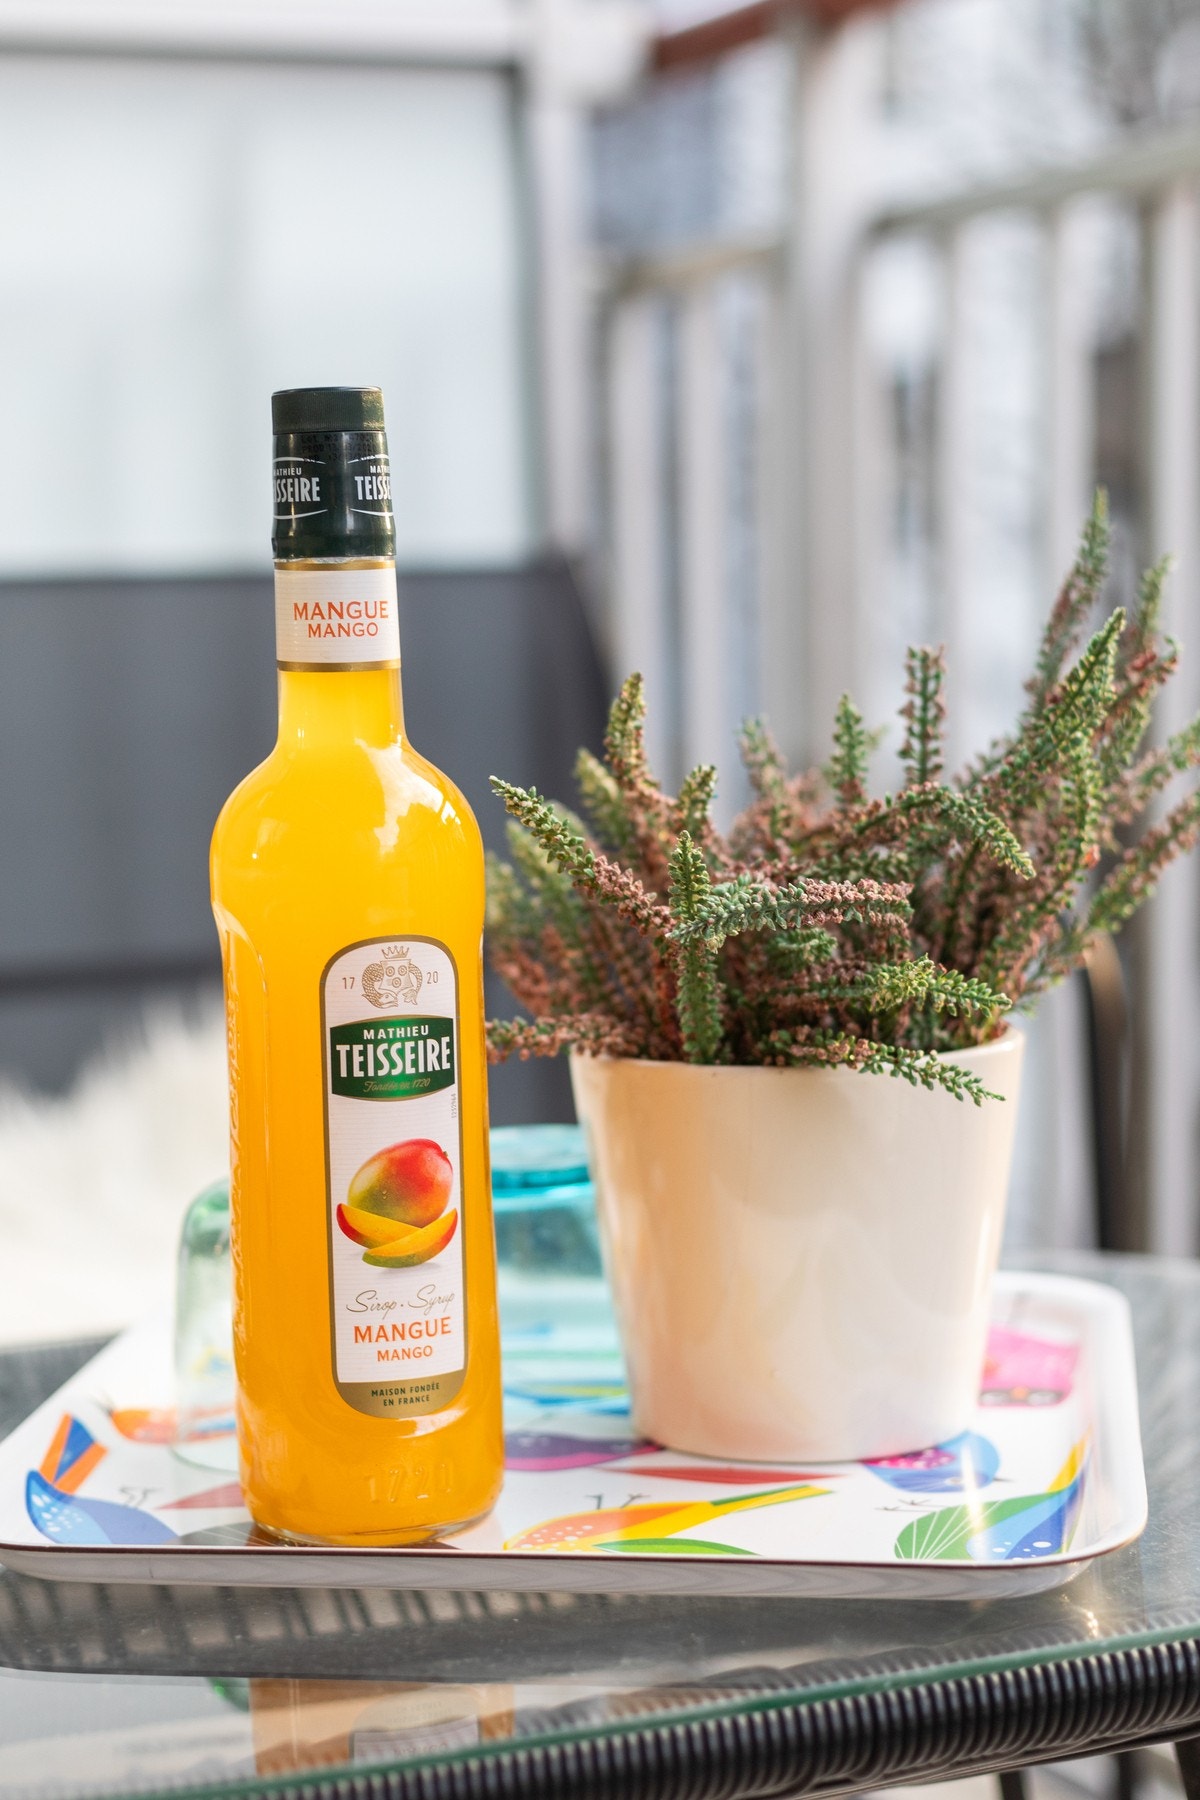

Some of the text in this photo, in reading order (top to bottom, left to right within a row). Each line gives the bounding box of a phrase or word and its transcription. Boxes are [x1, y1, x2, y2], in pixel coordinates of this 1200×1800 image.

[273, 477, 321, 503] ISSEIRE
[354, 475, 391, 500] TEISSE
[293, 600, 389, 621] MANGUE
[308, 621, 379, 638] MANGO
[342, 971, 439, 990] 17 20
[363, 1024, 430, 1040] MATHIEU
[335, 1036, 451, 1078] TEISSEIRE
[412, 1077, 432, 1089] 1720
[346, 1284, 455, 1320] Sirop Syrup
[353, 1316, 452, 1344] MANGUE
[376, 1345, 433, 1362] MANGO
[371, 1382, 441, 1398] MAISON FONDÉE
[383, 1394, 431, 1407] EN FRANCE
